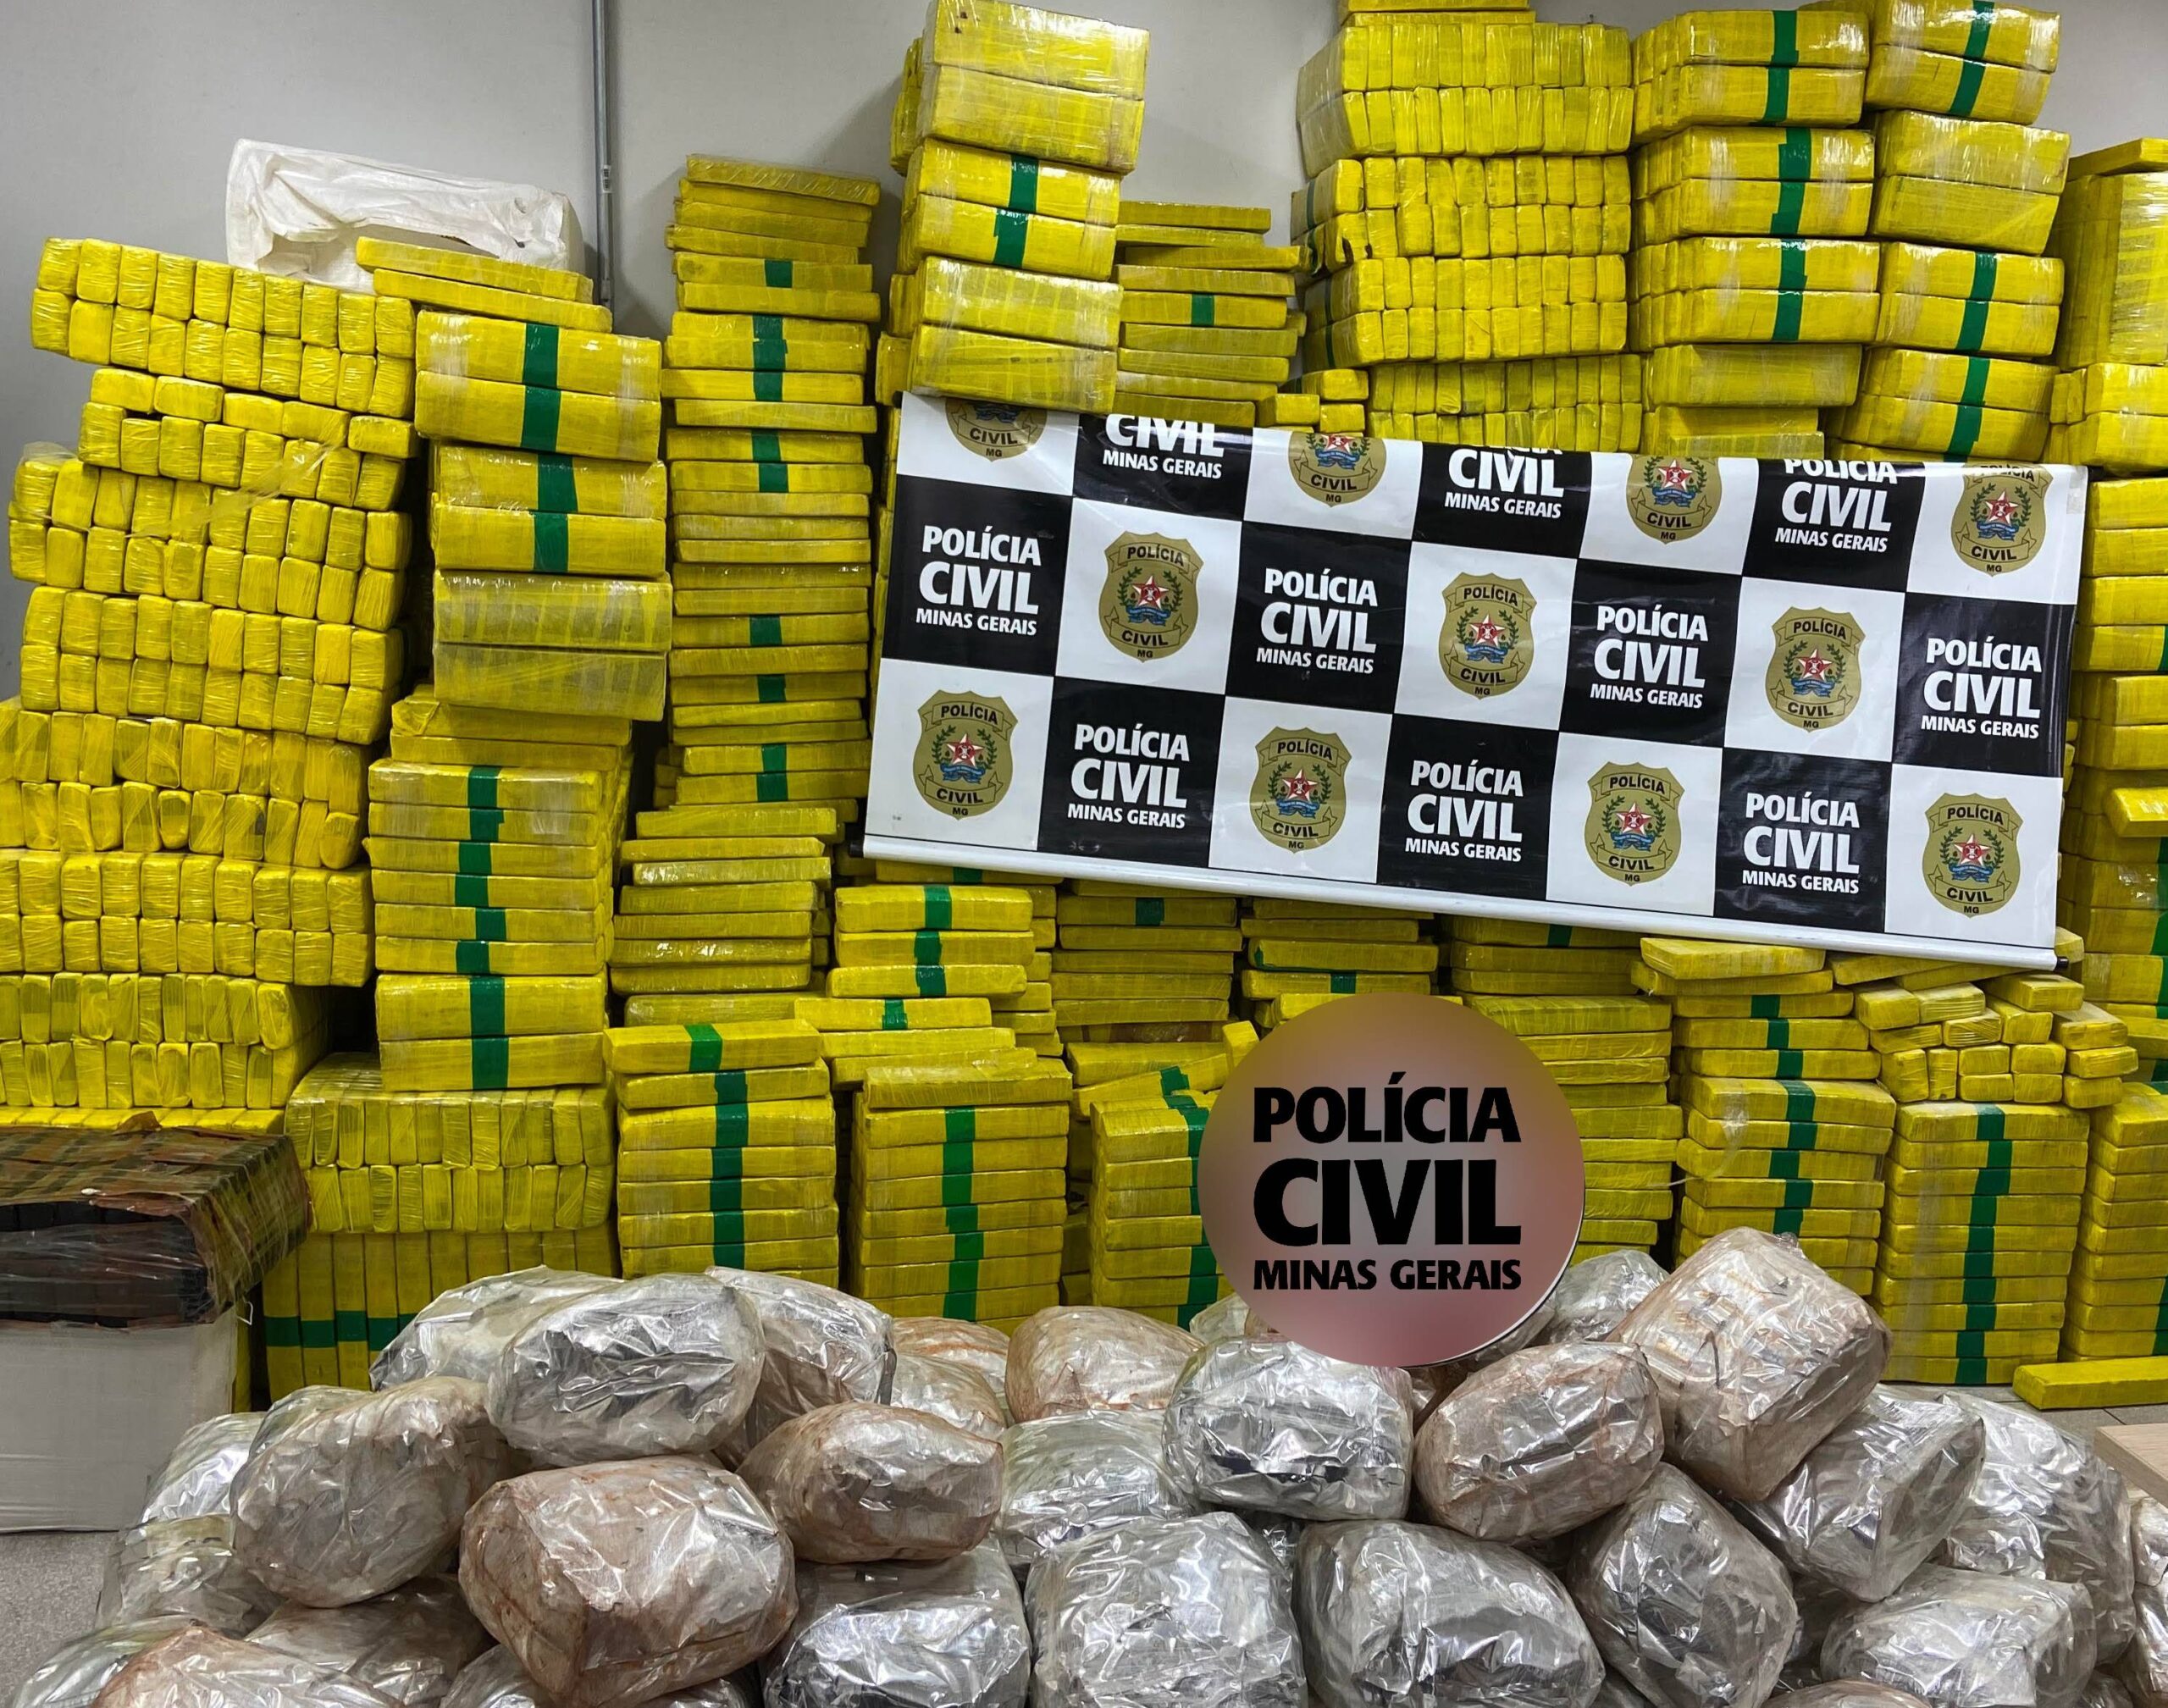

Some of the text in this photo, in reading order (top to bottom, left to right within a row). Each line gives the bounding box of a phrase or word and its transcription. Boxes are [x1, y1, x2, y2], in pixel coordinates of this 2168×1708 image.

[970, 428, 1018, 445] CIVIL
[1106, 413, 1225, 457] CIVIL
[986, 448, 1003, 457] MG
[1103, 449, 1222, 479] MINAS GERAIS
[1311, 474, 1357, 490] CIVIL
[1449, 449, 1565, 498] CIVIL
[1326, 494, 1341, 503] MG
[1445, 492, 1562, 519] MINAS GERAIS
[1782, 481, 1891, 532] CIVIL
[1647, 512, 1692, 528] CIVIL
[922, 525, 1042, 567] POLÍCIA
[1661, 532, 1676, 540] MG
[1775, 528, 1889, 553] MINAS GERAIS
[1127, 544, 1184, 567] POLÍCIA
[1972, 545, 2016, 561] CIVIL
[920, 561, 1038, 615] CIVIL
[1265, 568, 1378, 606] POLÍCIA
[1463, 585, 1518, 606] POLÍCIA
[916, 608, 1037, 636] MINAS GERAIS
[1261, 602, 1377, 654] CIVIL
[1597, 605, 1709, 642] POLÍCIA
[1794, 618, 1846, 639] POLÍCIA
[1121, 630, 1168, 646] CIVIL
[1137, 649, 1153, 658] MG
[1257, 648, 1374, 674] MINAS GERAIS
[1595, 638, 1706, 688] CIVIL
[1927, 636, 2043, 673] POLÍCIA
[1460, 667, 1506, 683] CIVIL
[1474, 687, 1490, 695] MG
[1590, 684, 1703, 709] MINAS GERAIS
[1924, 671, 2041, 719] CIVIL
[941, 703, 998, 725] POLÍCIA
[1788, 702, 1833, 716] CIVIL
[1922, 716, 2039, 739] MINAS GERAIS
[1075, 723, 1190, 762] POLÍCIA
[1277, 738, 1332, 760] POLÍCIA
[1071, 759, 1187, 809] CIVIL
[1411, 760, 1524, 797] POLÍCIA
[1609, 774, 1665, 794] POLÍCIA
[937, 788, 983, 804] CIVIL
[953, 807, 969, 815] MG
[1068, 804, 1186, 829] MINAS GERAIS
[1408, 794, 1523, 843] CIVIL
[1746, 792, 1861, 828] POLÍCIA
[1948, 804, 2004, 825] POLÍCIA
[1273, 822, 1319, 837] CIVIL
[1288, 841, 1304, 849] MG
[1406, 838, 1522, 862] MINAS GERAIS
[1744, 826, 1860, 875] CIVIL
[1608, 856, 1654, 871] CIVIL
[1624, 874, 1640, 882] MG
[1743, 871, 1860, 894] MINAS GERAIS
[1947, 887, 1993, 903] CIVIL
